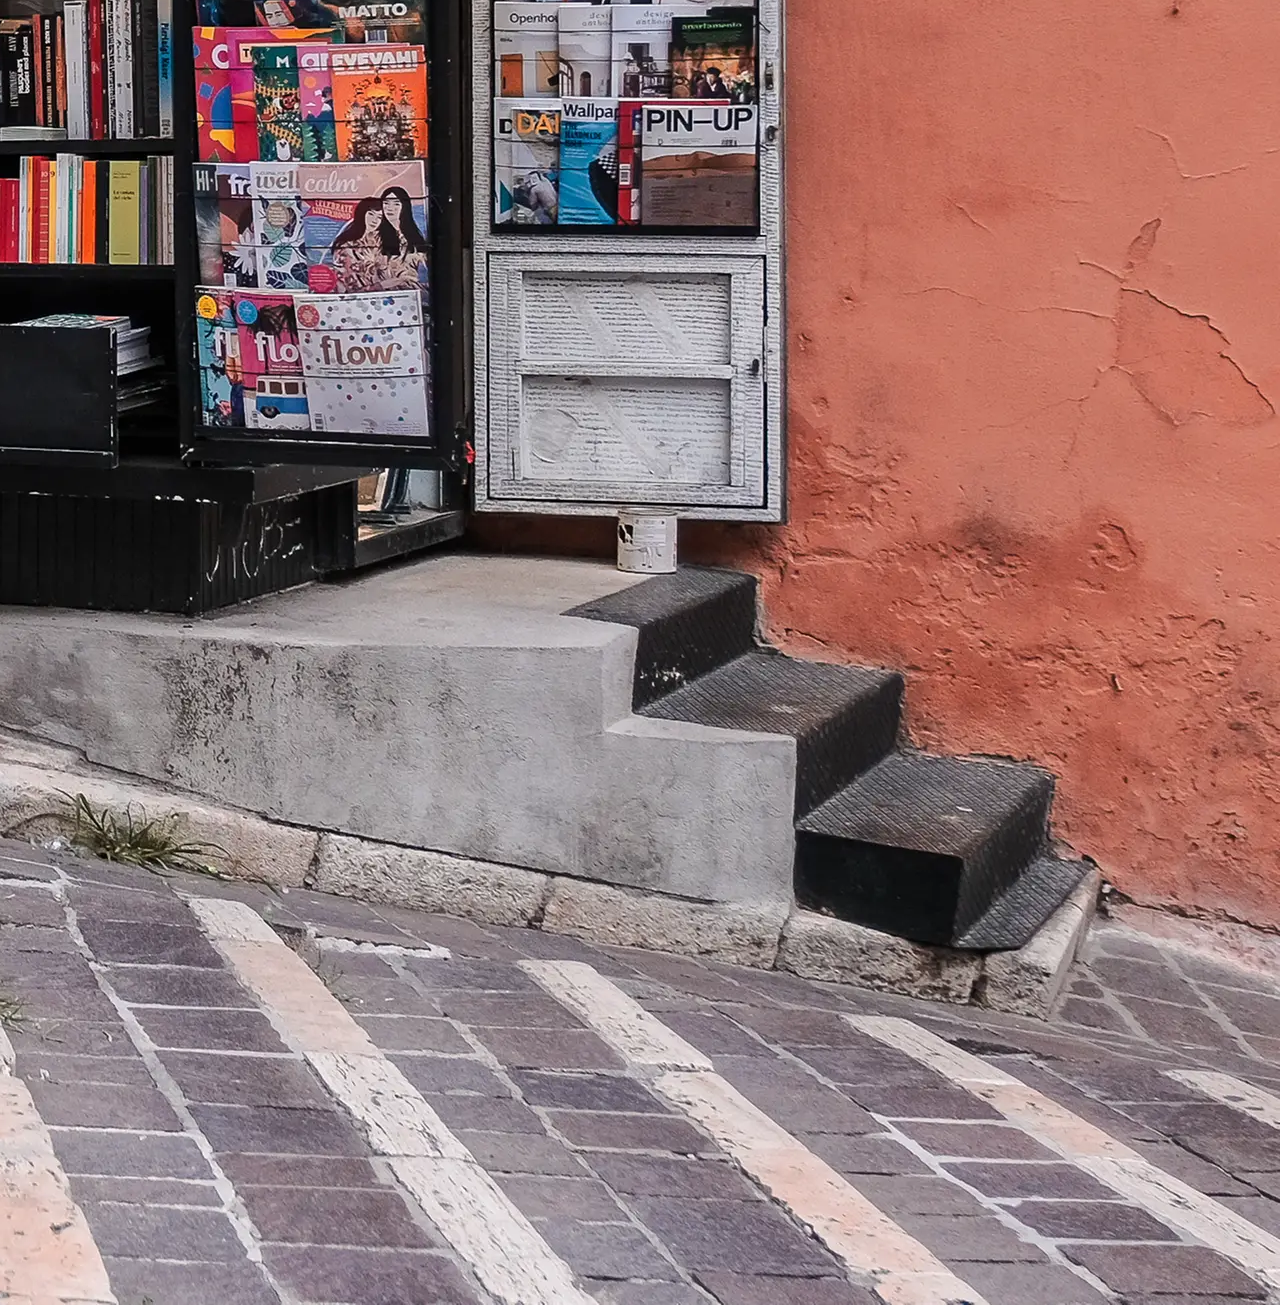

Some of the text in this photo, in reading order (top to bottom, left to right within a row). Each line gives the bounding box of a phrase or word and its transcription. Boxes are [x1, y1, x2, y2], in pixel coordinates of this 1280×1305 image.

[339, 3, 409, 19] MATTO
[304, 170, 359, 193] calm
[314, 200, 355, 213] CELEBRATE
[320, 335, 402, 366] flow
